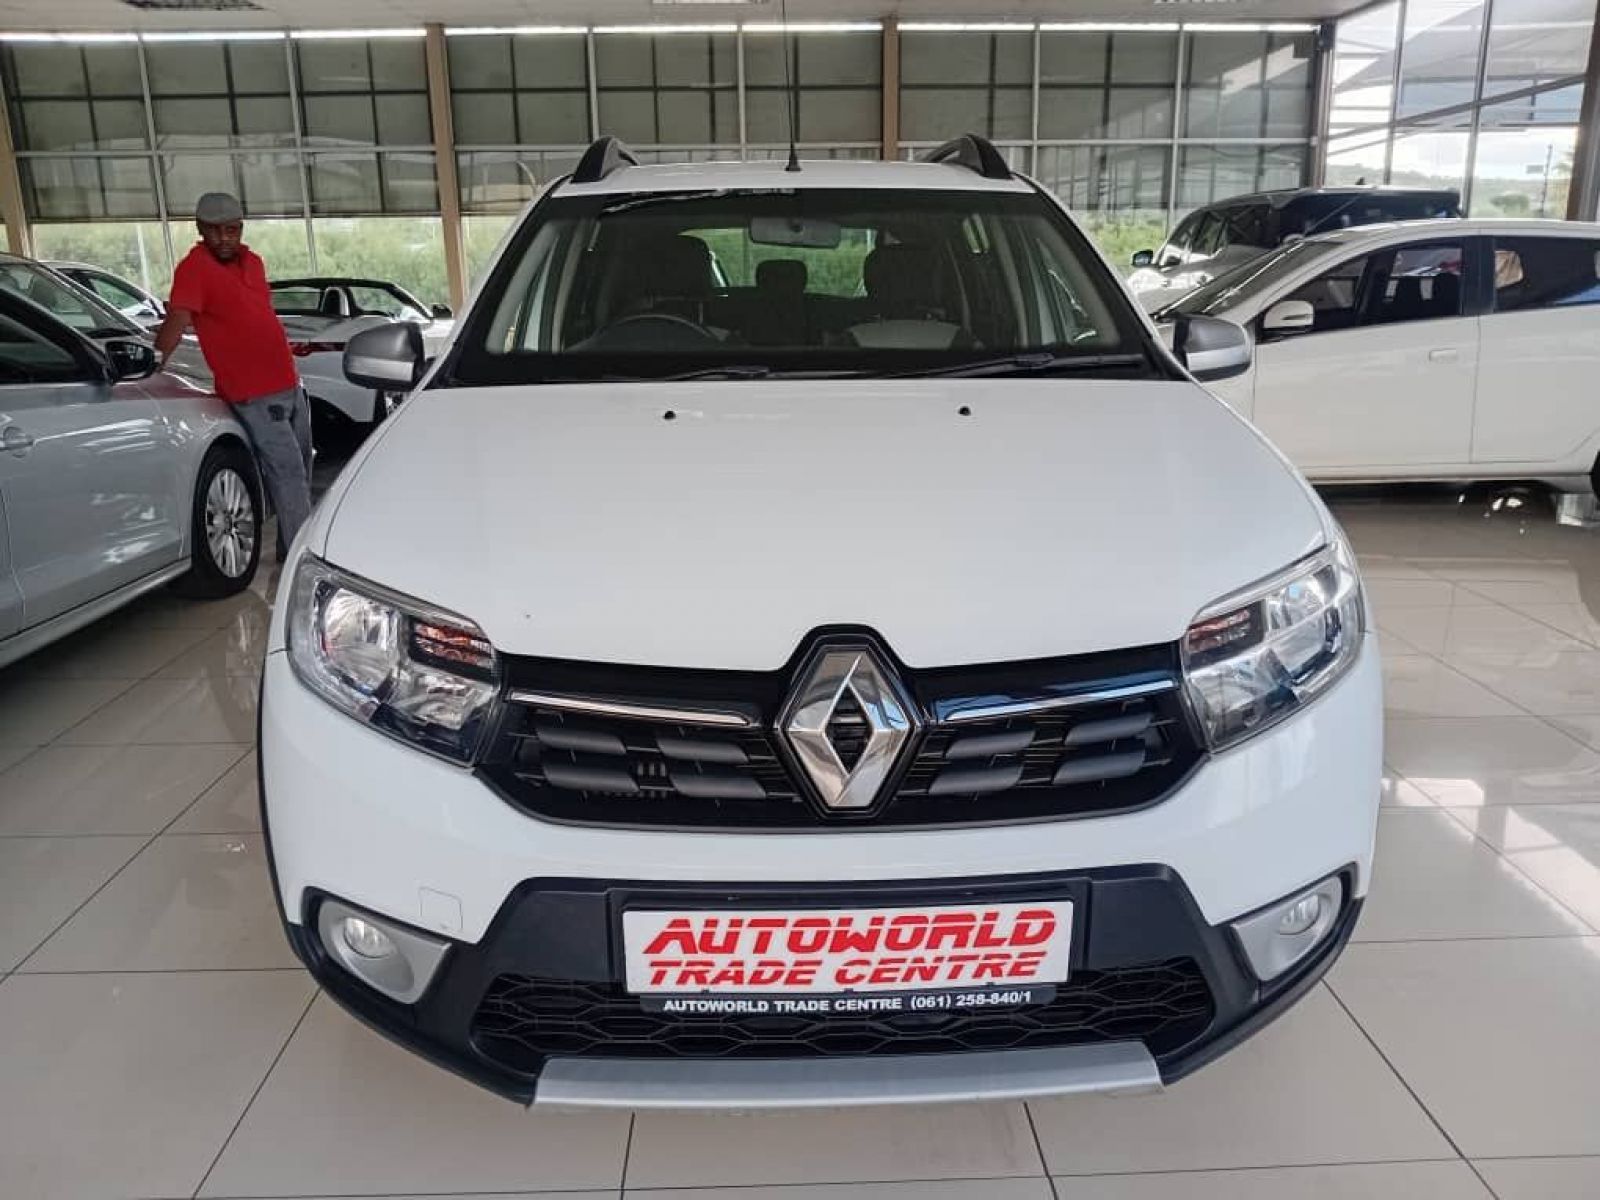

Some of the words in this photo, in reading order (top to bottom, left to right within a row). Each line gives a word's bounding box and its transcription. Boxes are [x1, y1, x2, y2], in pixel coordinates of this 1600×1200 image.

[642, 909, 1056, 955] AUTOWORLD
[649, 959, 823, 986] TRADE
[834, 951, 1048, 985] CENTRE
[663, 1000, 769, 1013] AUTOWORLD
[773, 1000, 829, 1012] TRADE
[834, 998, 902, 1011] CENTRE
[911, 995, 951, 1009] (061)
